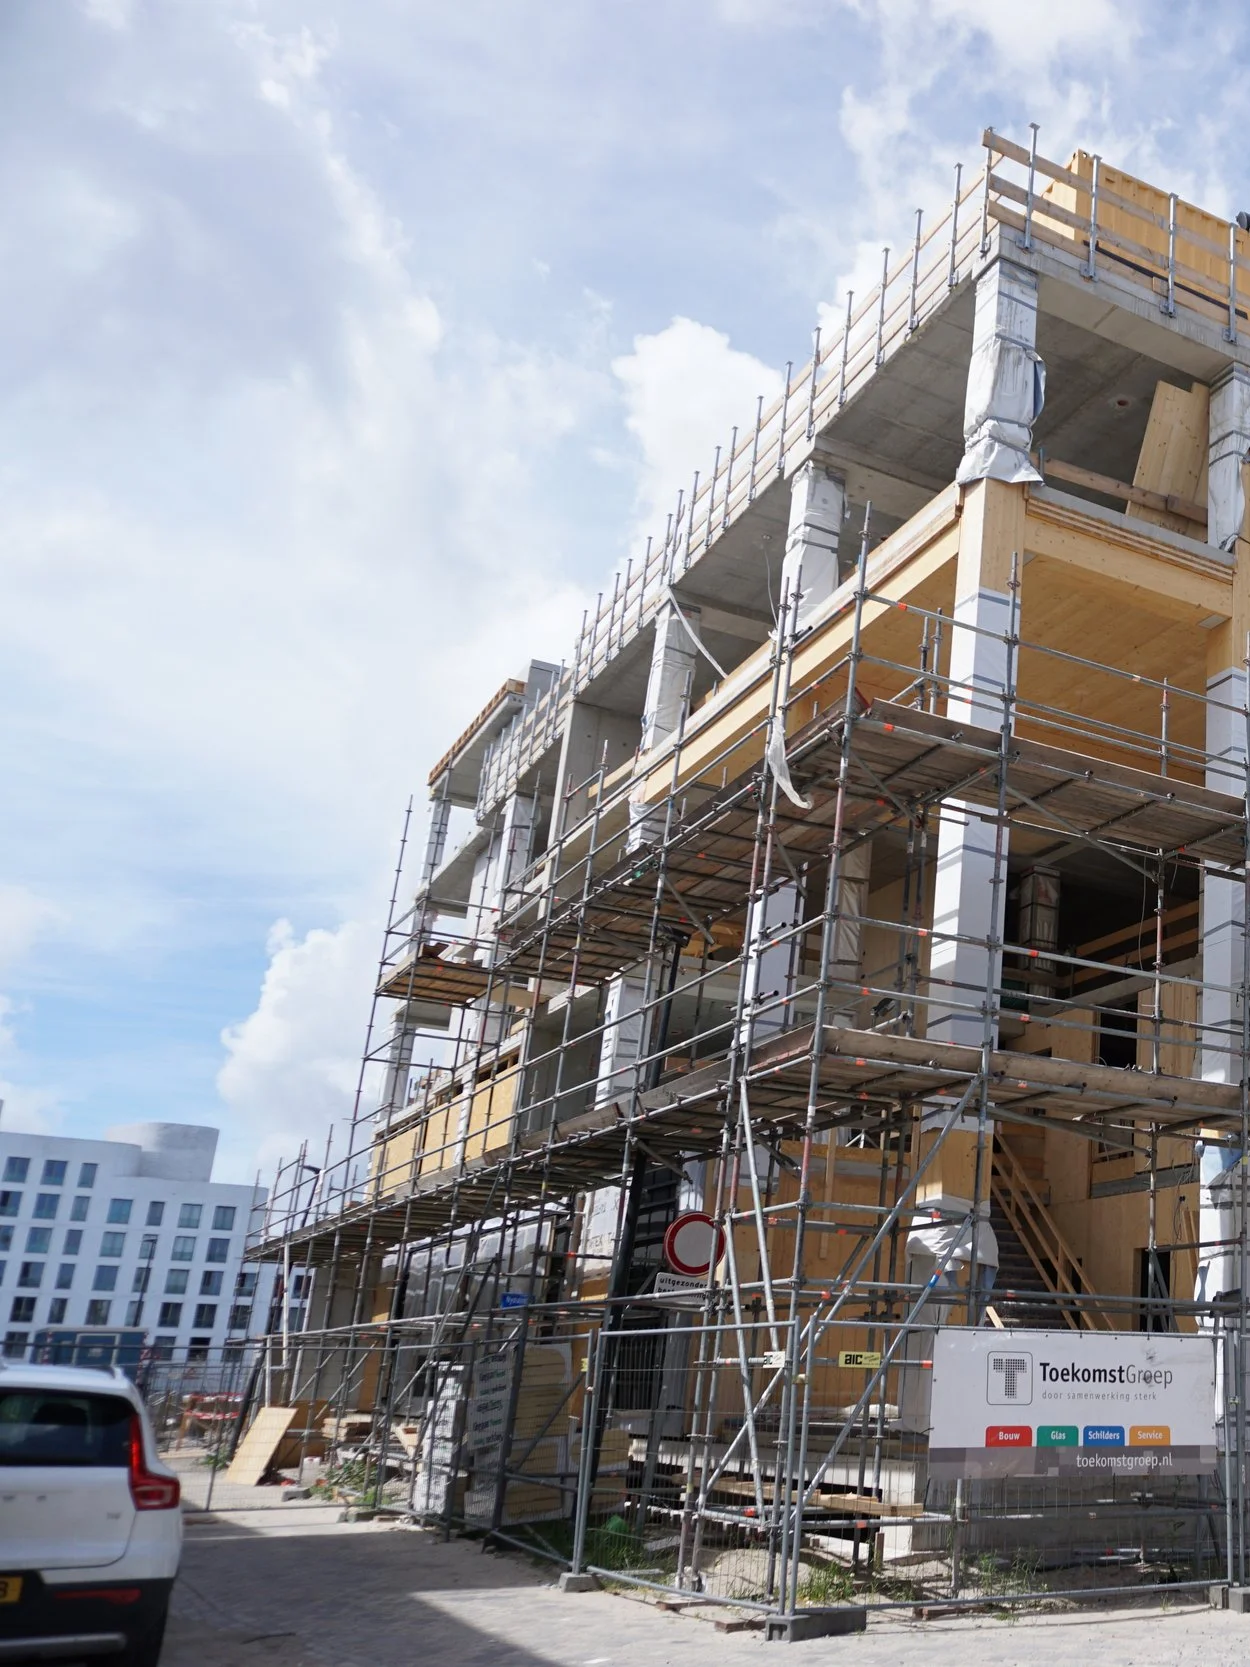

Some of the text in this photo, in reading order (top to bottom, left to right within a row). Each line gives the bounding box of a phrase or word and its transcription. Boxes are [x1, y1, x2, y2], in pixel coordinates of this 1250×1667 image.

[1039, 1362, 1173, 1389] ToekomstGroep
[1042, 1389, 1157, 1402] door samenwerking sterk
[998, 1431, 1163, 1440] Bouw Glas Schilders Service
[1076, 1452, 1173, 1470] toekomstgroep.nl
